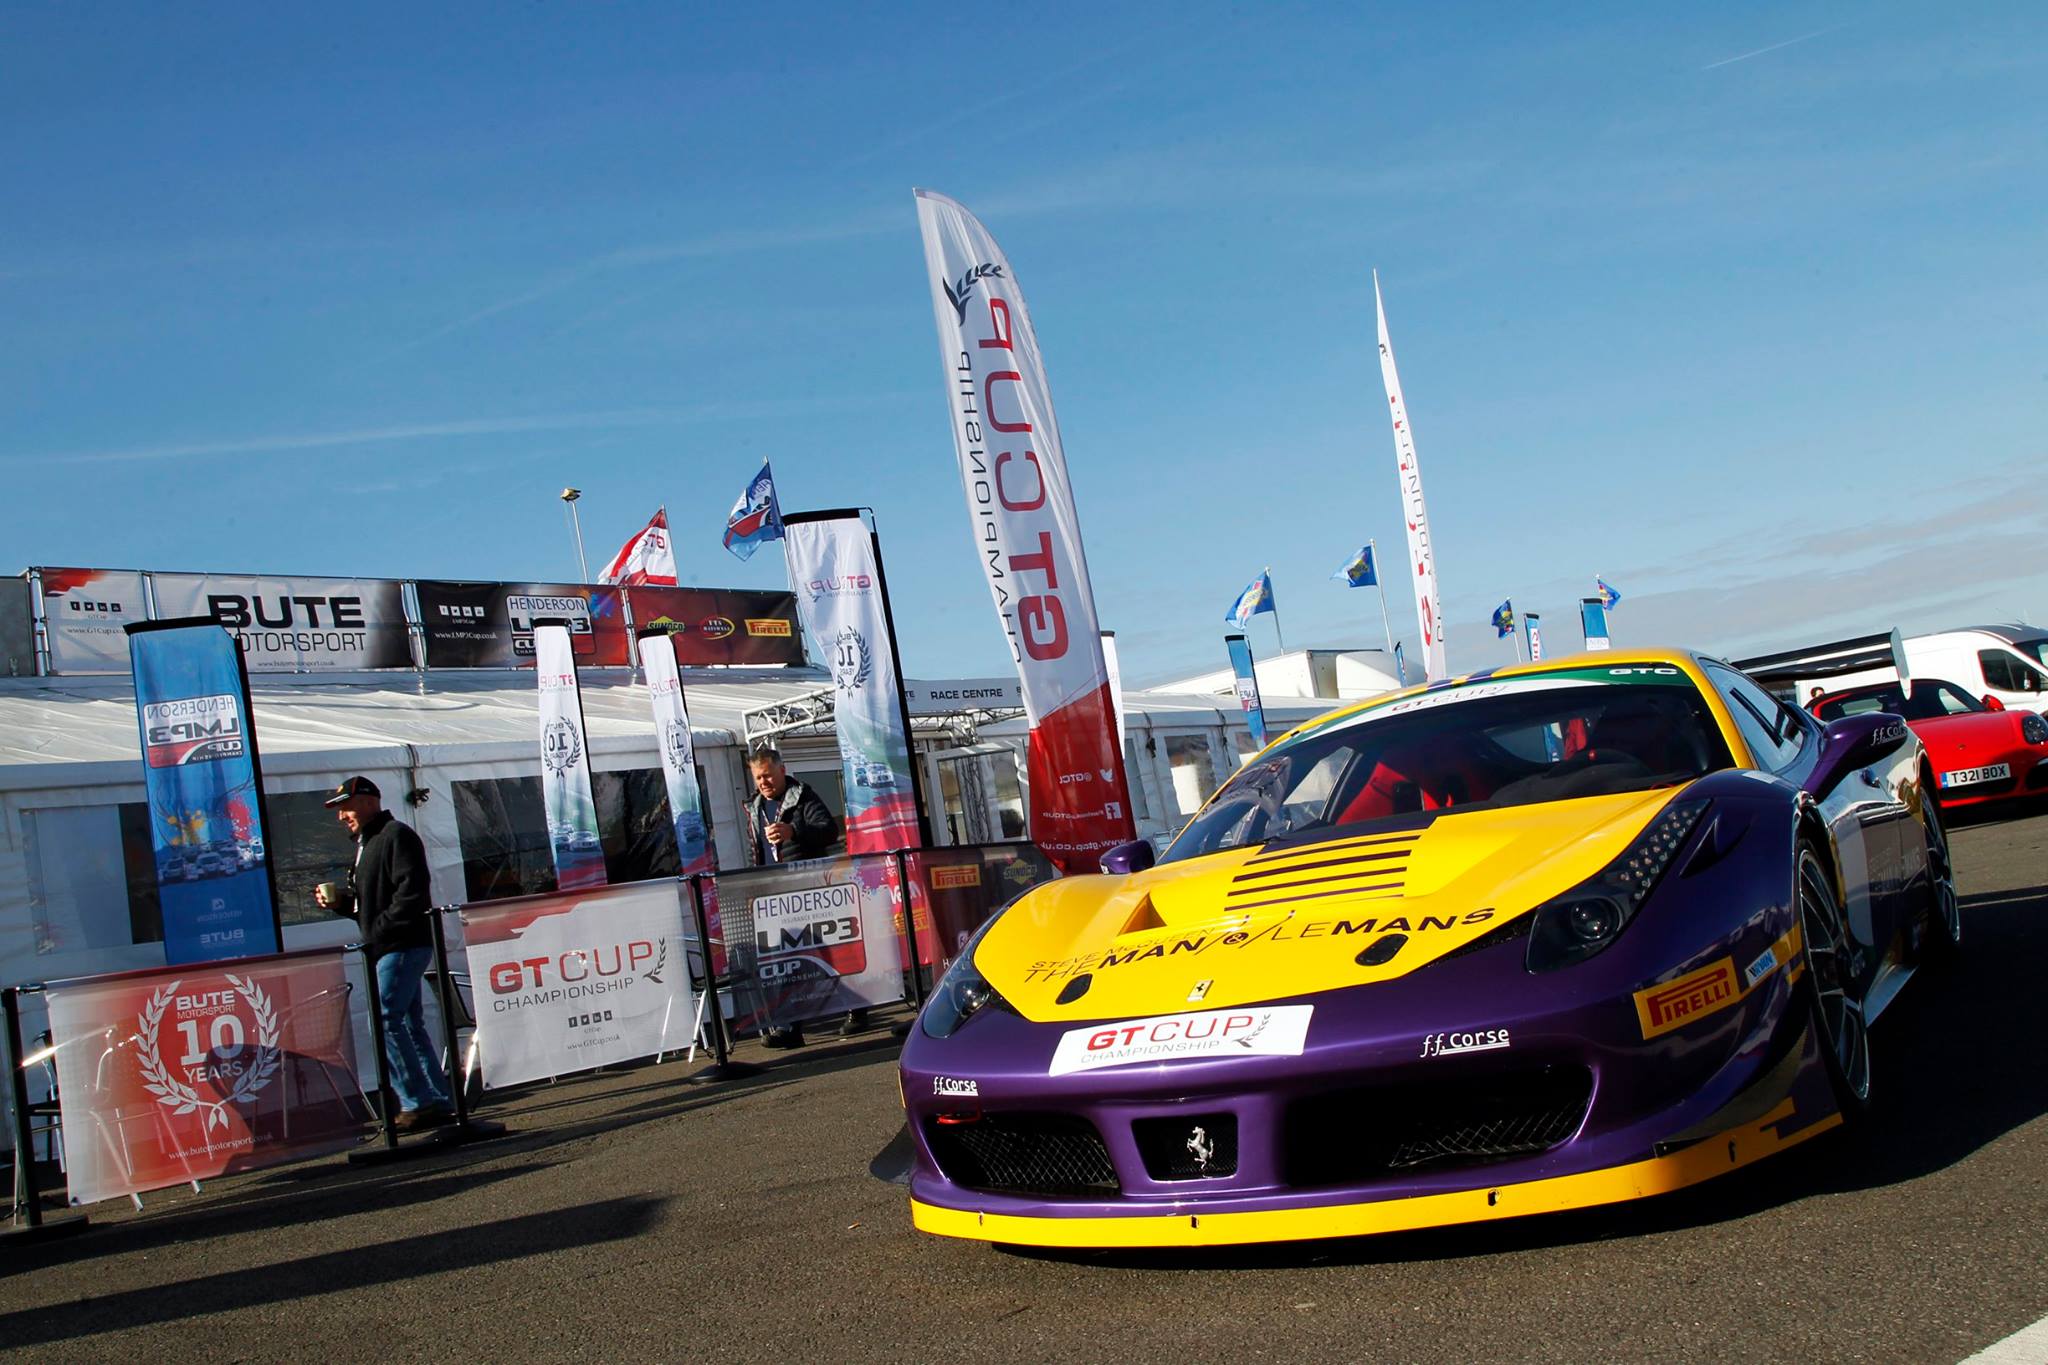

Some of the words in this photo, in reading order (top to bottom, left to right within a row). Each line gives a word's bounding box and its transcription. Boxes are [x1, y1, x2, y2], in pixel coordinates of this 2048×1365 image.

[208, 595, 365, 629] BUTE
[509, 597, 585, 612] HENDERSON
[749, 622, 789, 634] PIRELLI
[230, 632, 366, 651] OTORSPORT
[515, 640, 536, 649] CU
[931, 690, 959, 700] RACE
[962, 688, 1003, 699] CENTRE
[1951, 769, 1979, 784] T321
[1982, 765, 2006, 780] BOX
[935, 869, 978, 889] PIRELLI
[1004, 864, 1037, 880] SUNOCO
[757, 887, 856, 919] HENDERSON
[757, 916, 861, 954] LMP3
[489, 956, 550, 995] GT
[559, 940, 654, 983] CUP
[759, 960, 800, 980] CUP
[1032, 951, 1101, 969] STEVE
[761, 971, 822, 989] CHAMPIONSHIP
[176, 990, 236, 1011] BUTE
[493, 976, 635, 1013] CHAMPIONSHIP
[1647, 967, 1731, 1028] PIRELLI
[177, 1004, 236, 1019] MOTORSPORT
[177, 1014, 245, 1066] 10
[1087, 1026, 1146, 1051] GT
[1149, 1015, 1254, 1042] CUP
[1081, 1040, 1221, 1064] CHAMPIONSHIP
[183, 1060, 243, 1084] YEARS
[169, 1132, 274, 1160] www.butemotorsport.co.uk
